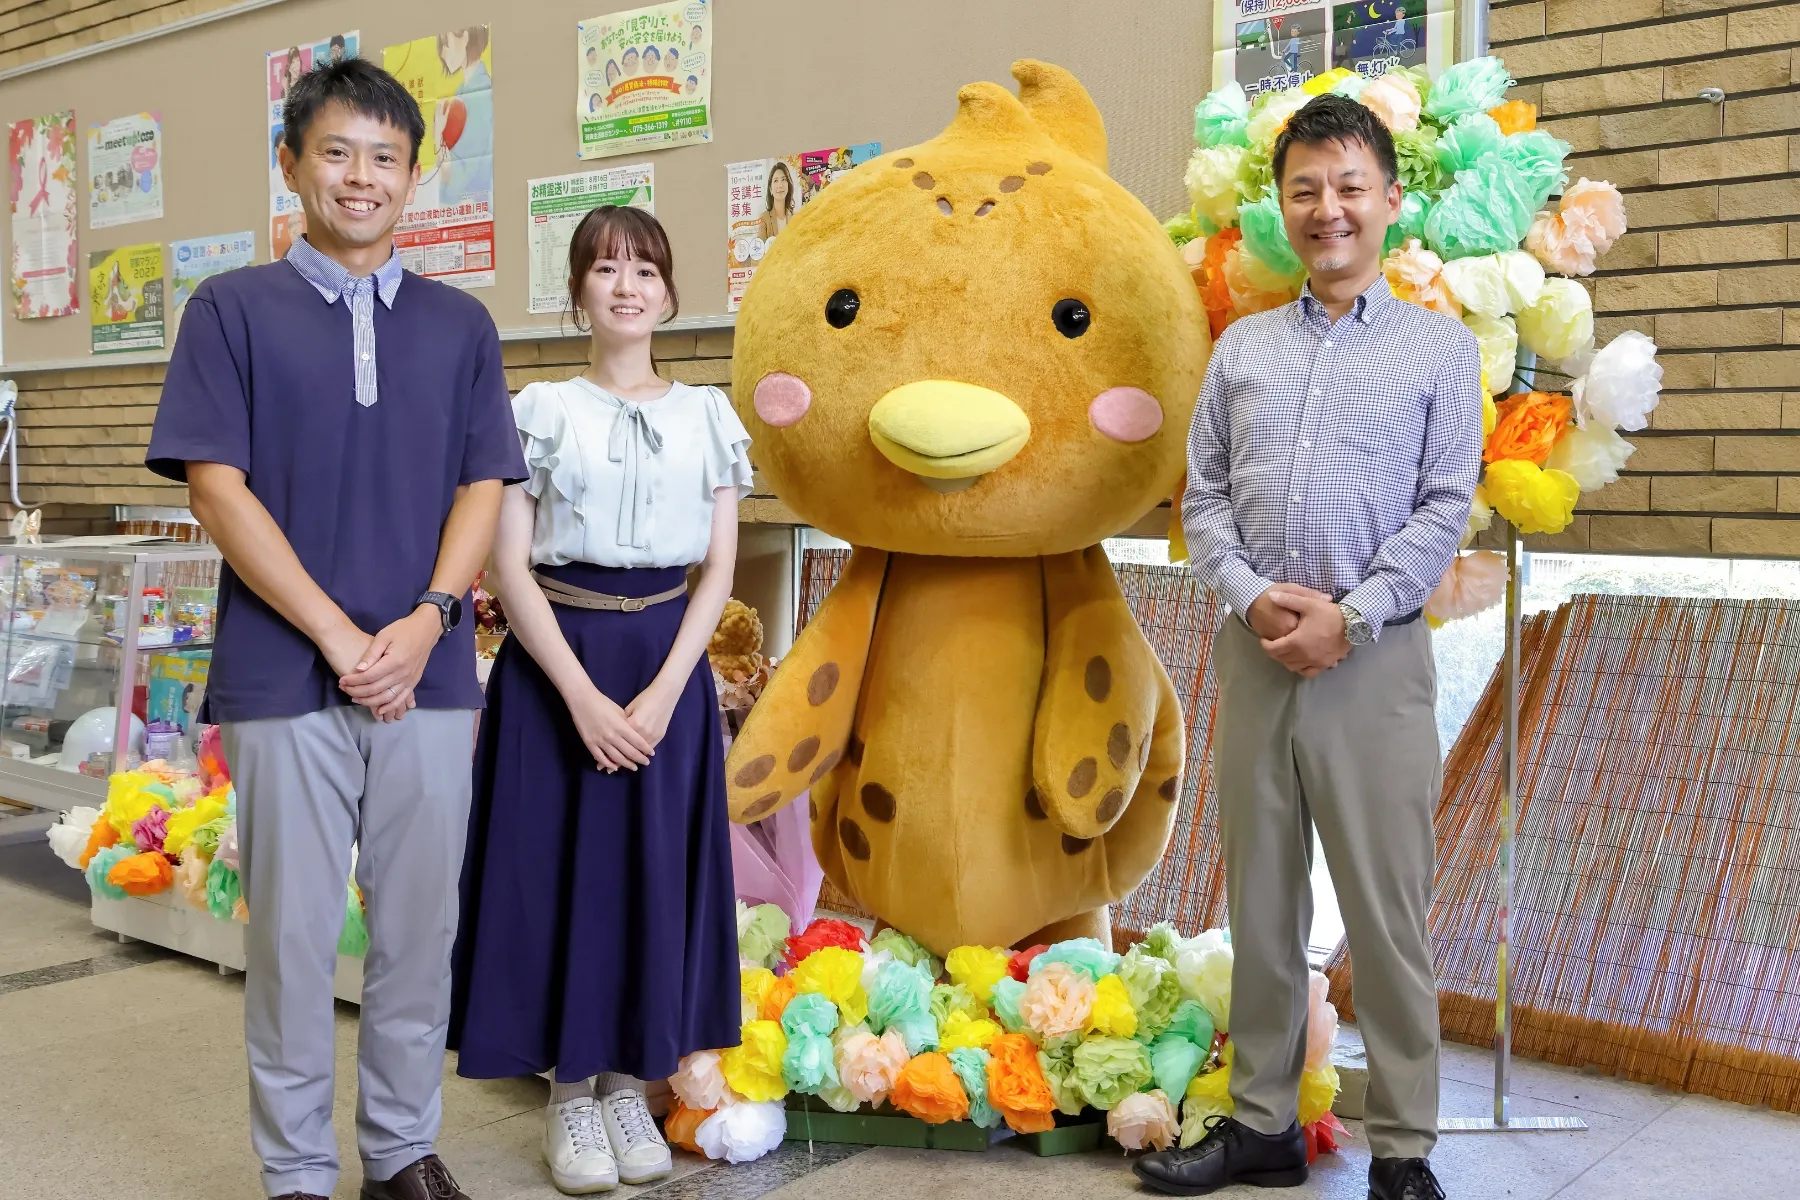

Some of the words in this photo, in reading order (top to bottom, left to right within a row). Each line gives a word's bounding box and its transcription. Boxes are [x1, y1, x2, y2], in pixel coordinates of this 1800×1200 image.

[600, 28, 625, 50] あなたの
[1245, 73, 1315, 93] 一時不停止
[632, 121, 668, 133] 075-366-1319
[675, 117, 692, 126] #9110
[532, 180, 569, 198] お精霊送り
[731, 184, 762, 202] 受講生
[731, 202, 752, 217] 募集
